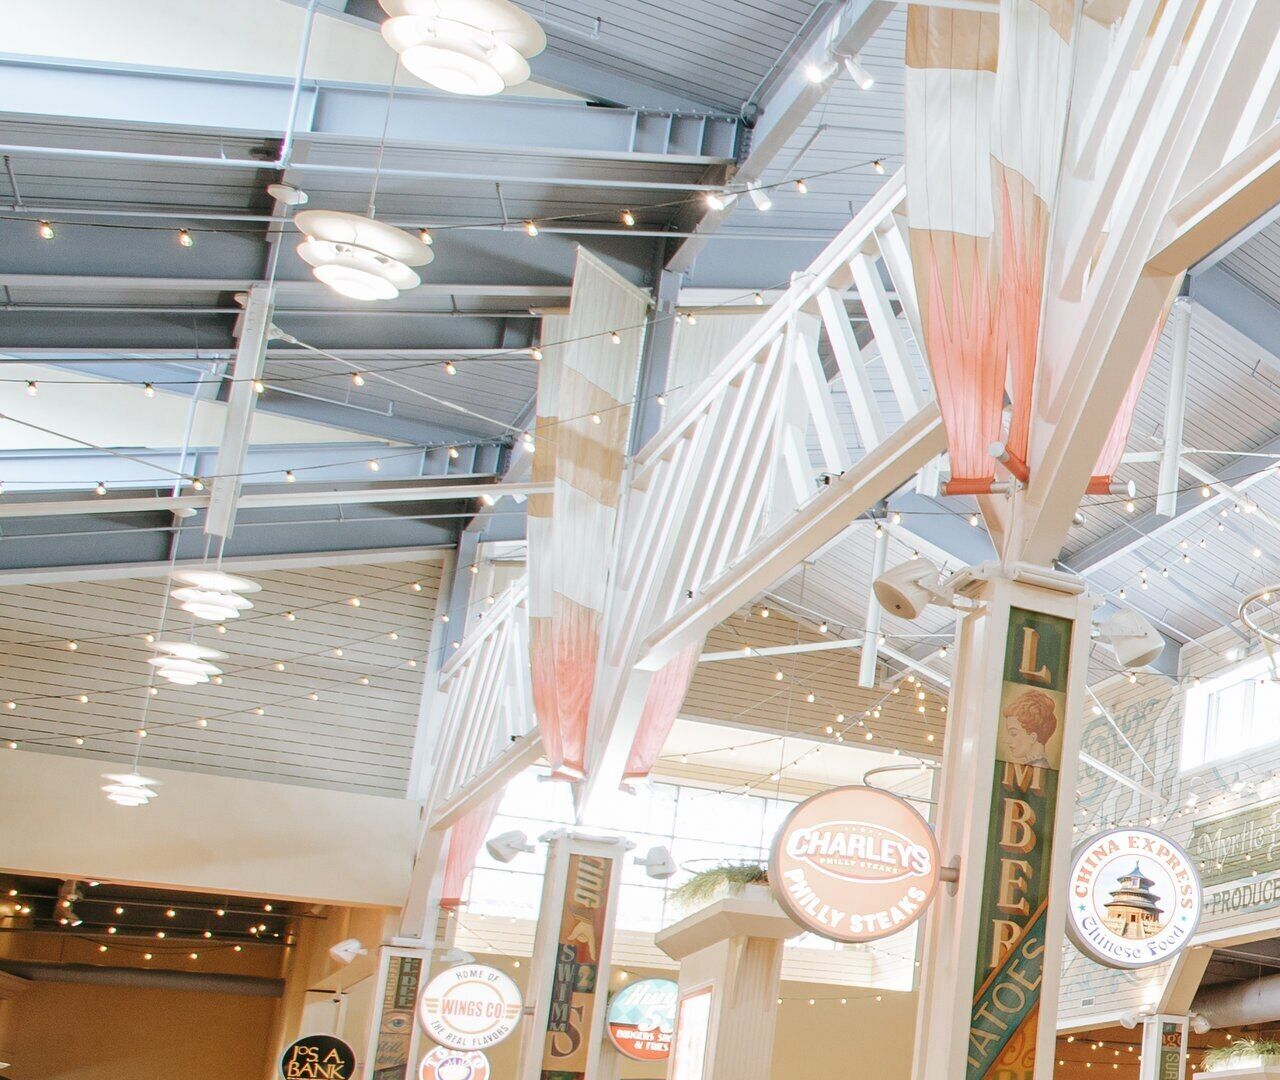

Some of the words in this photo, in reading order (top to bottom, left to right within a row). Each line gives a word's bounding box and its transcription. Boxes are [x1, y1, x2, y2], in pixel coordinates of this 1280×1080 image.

[991, 626, 1052, 969] LMBER
[1197, 820, 1264, 875] Myrtle
[1075, 839, 1121, 898] CHINA
[1127, 836, 1193, 910] EXPRESS
[784, 868, 846, 928] PHILLY
[850, 886, 927, 933] STEAKS
[1082, 916, 1141, 959] Chinese
[1146, 925, 1185, 957] Food
[456, 969, 483, 981] HOME
[488, 973, 500, 982] OF
[441, 999, 482, 1018] WINGS
[431, 1020, 445, 1035] THE
[445, 1033, 466, 1046] REAL
[472, 1024, 509, 1046] FLAVORS
[287, 1060, 346, 1080] BANK
